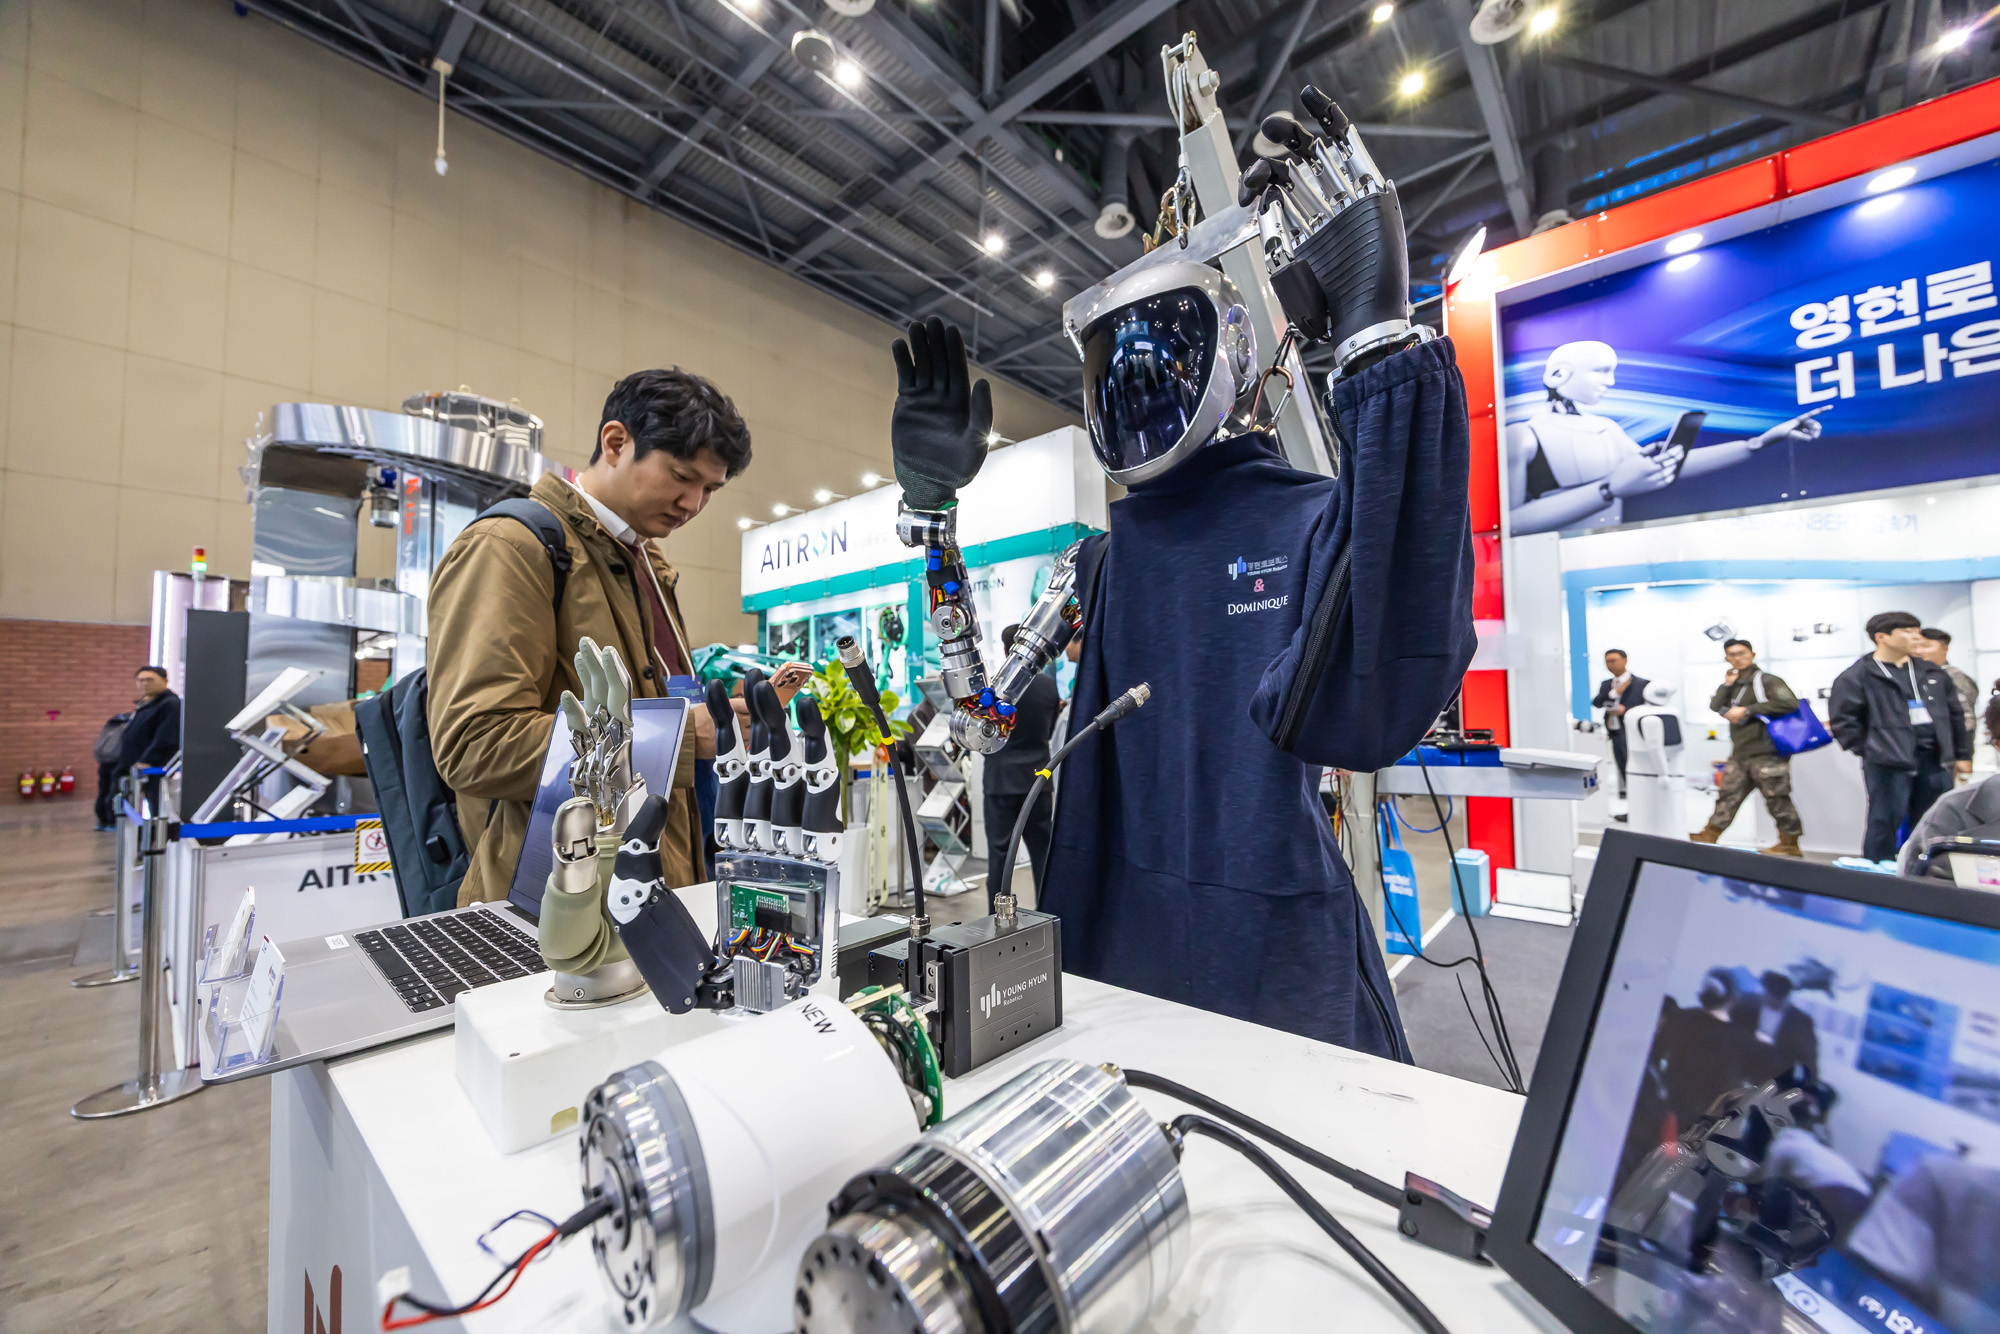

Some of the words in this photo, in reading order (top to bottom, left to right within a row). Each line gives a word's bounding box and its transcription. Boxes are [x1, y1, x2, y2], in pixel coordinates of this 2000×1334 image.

[1790, 260, 1998, 349] 영현로
[1795, 351, 1856, 405] 더
[1877, 319, 2000, 388] 나은
[1253, 578, 1265, 593] &
[1227, 595, 1289, 616] DOMINIQUE
[1002, 981, 1027, 998] YOUNG
[1028, 972, 1048, 989] HYUN
[1003, 994, 1023, 1007] Robotics
[801, 1002, 837, 1034] NEW
